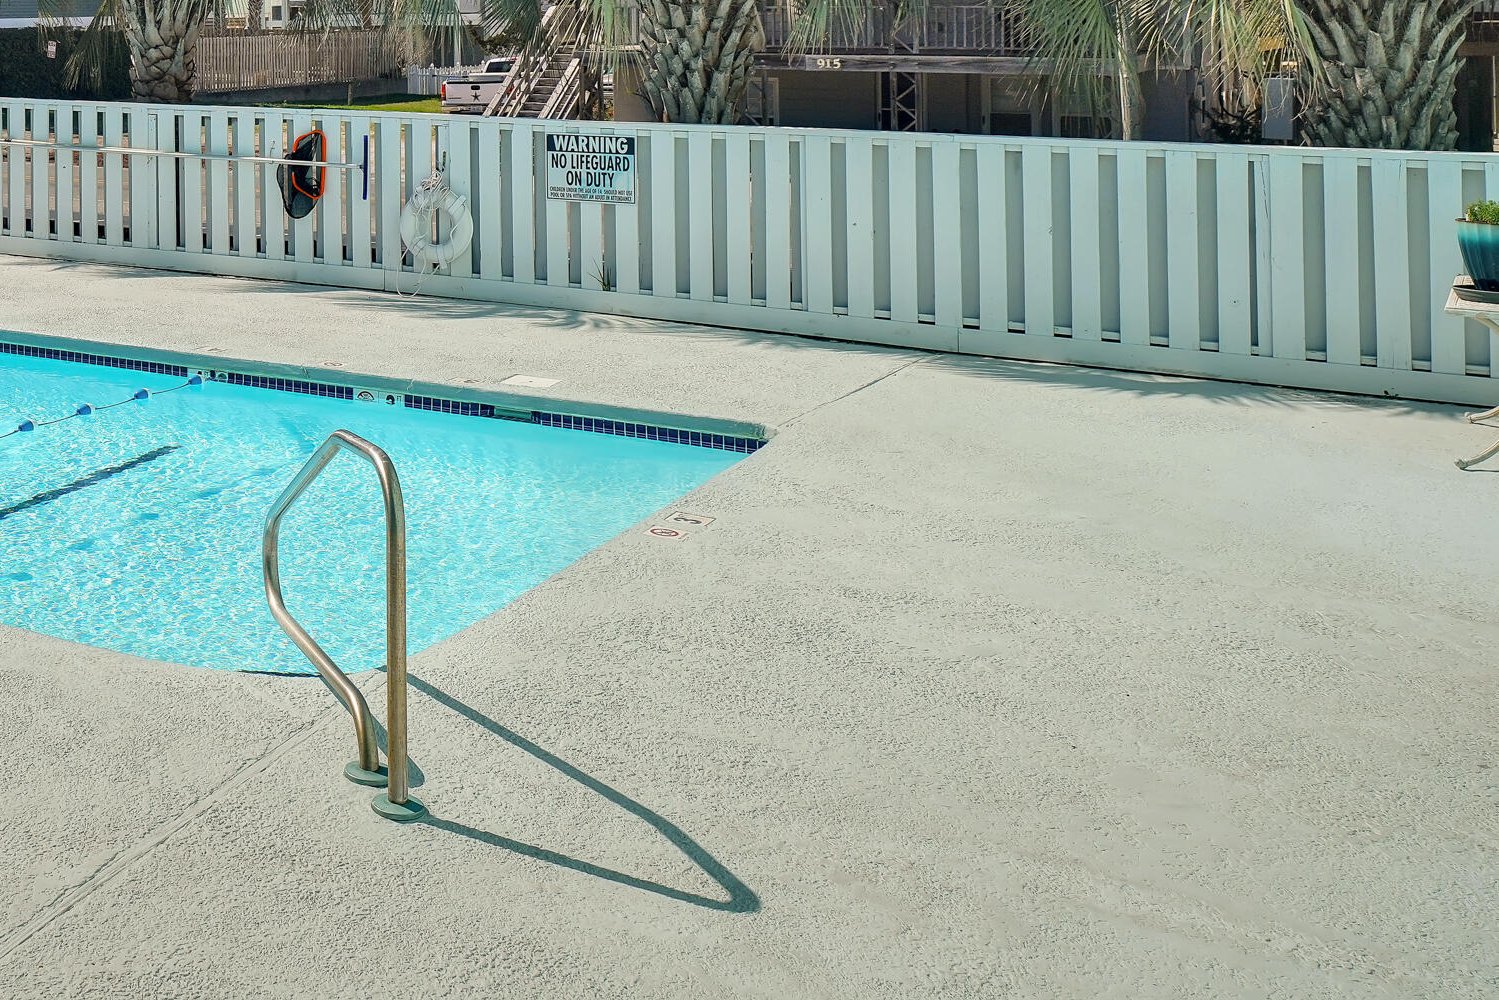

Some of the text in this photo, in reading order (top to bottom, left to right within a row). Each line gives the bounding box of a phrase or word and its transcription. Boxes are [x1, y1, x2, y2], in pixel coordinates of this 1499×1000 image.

[817, 58, 841, 69] 915
[553, 135, 628, 154] WARNING
[551, 153, 630, 172] NO LIFEGUARD
[566, 171, 615, 188] ON DUTY
